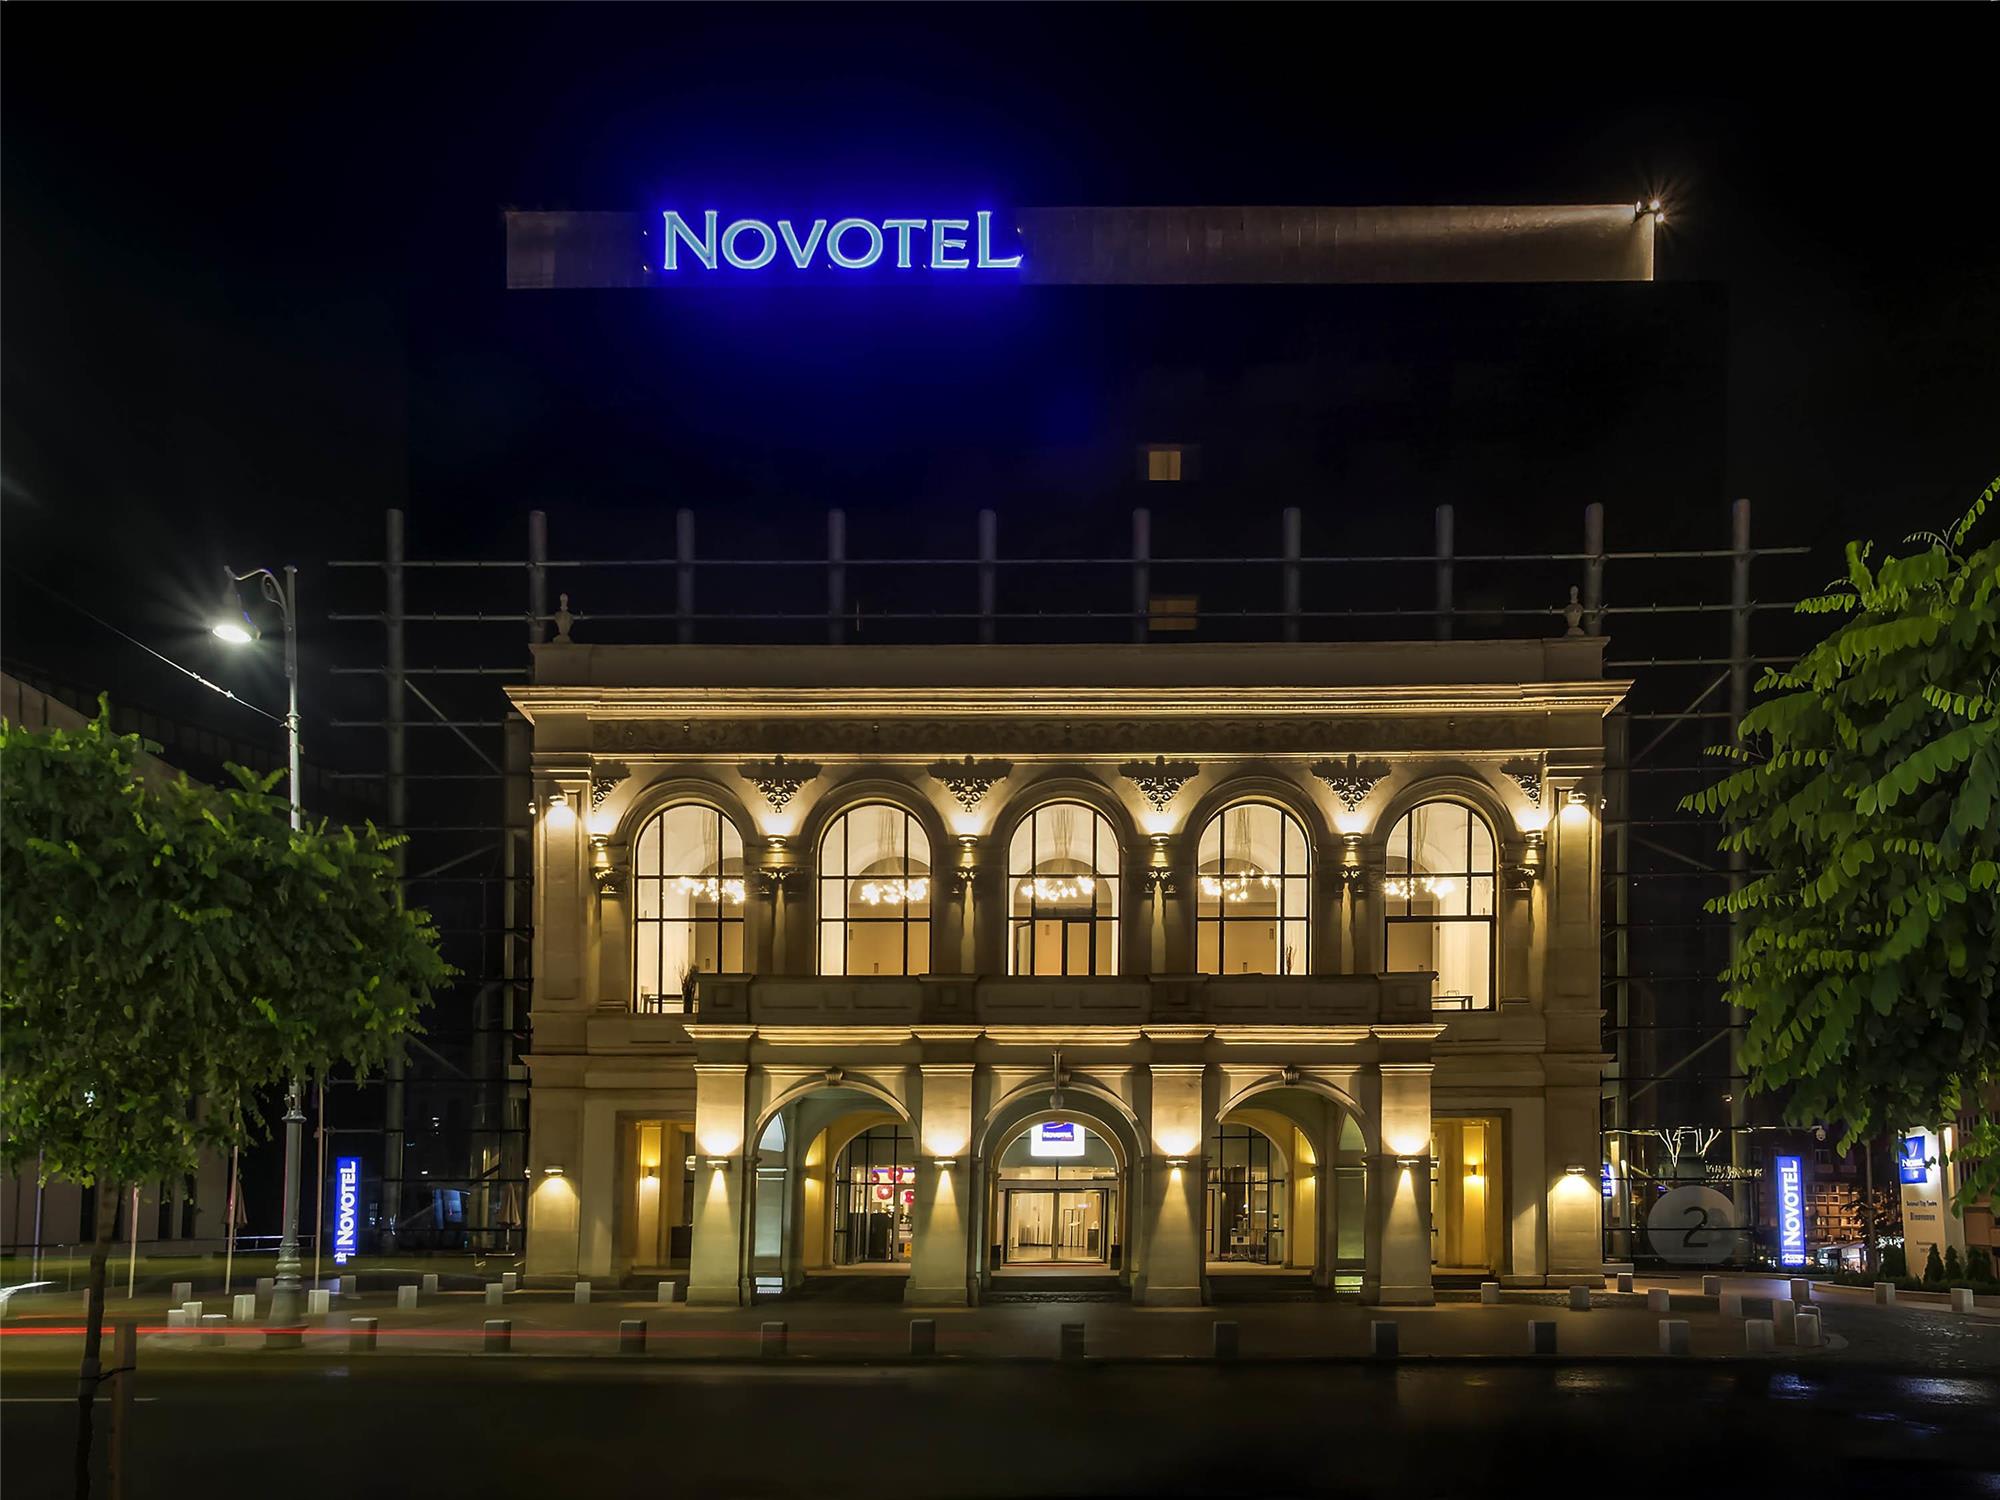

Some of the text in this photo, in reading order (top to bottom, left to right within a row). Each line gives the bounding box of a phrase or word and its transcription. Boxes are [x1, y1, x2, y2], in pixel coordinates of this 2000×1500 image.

[663, 210, 1023, 270] NOVOTEL
[336, 1160, 356, 1245] NOVOTEL
[1683, 1206, 1709, 1248] 2
[1780, 1159, 1801, 1246] NOVOTEL
